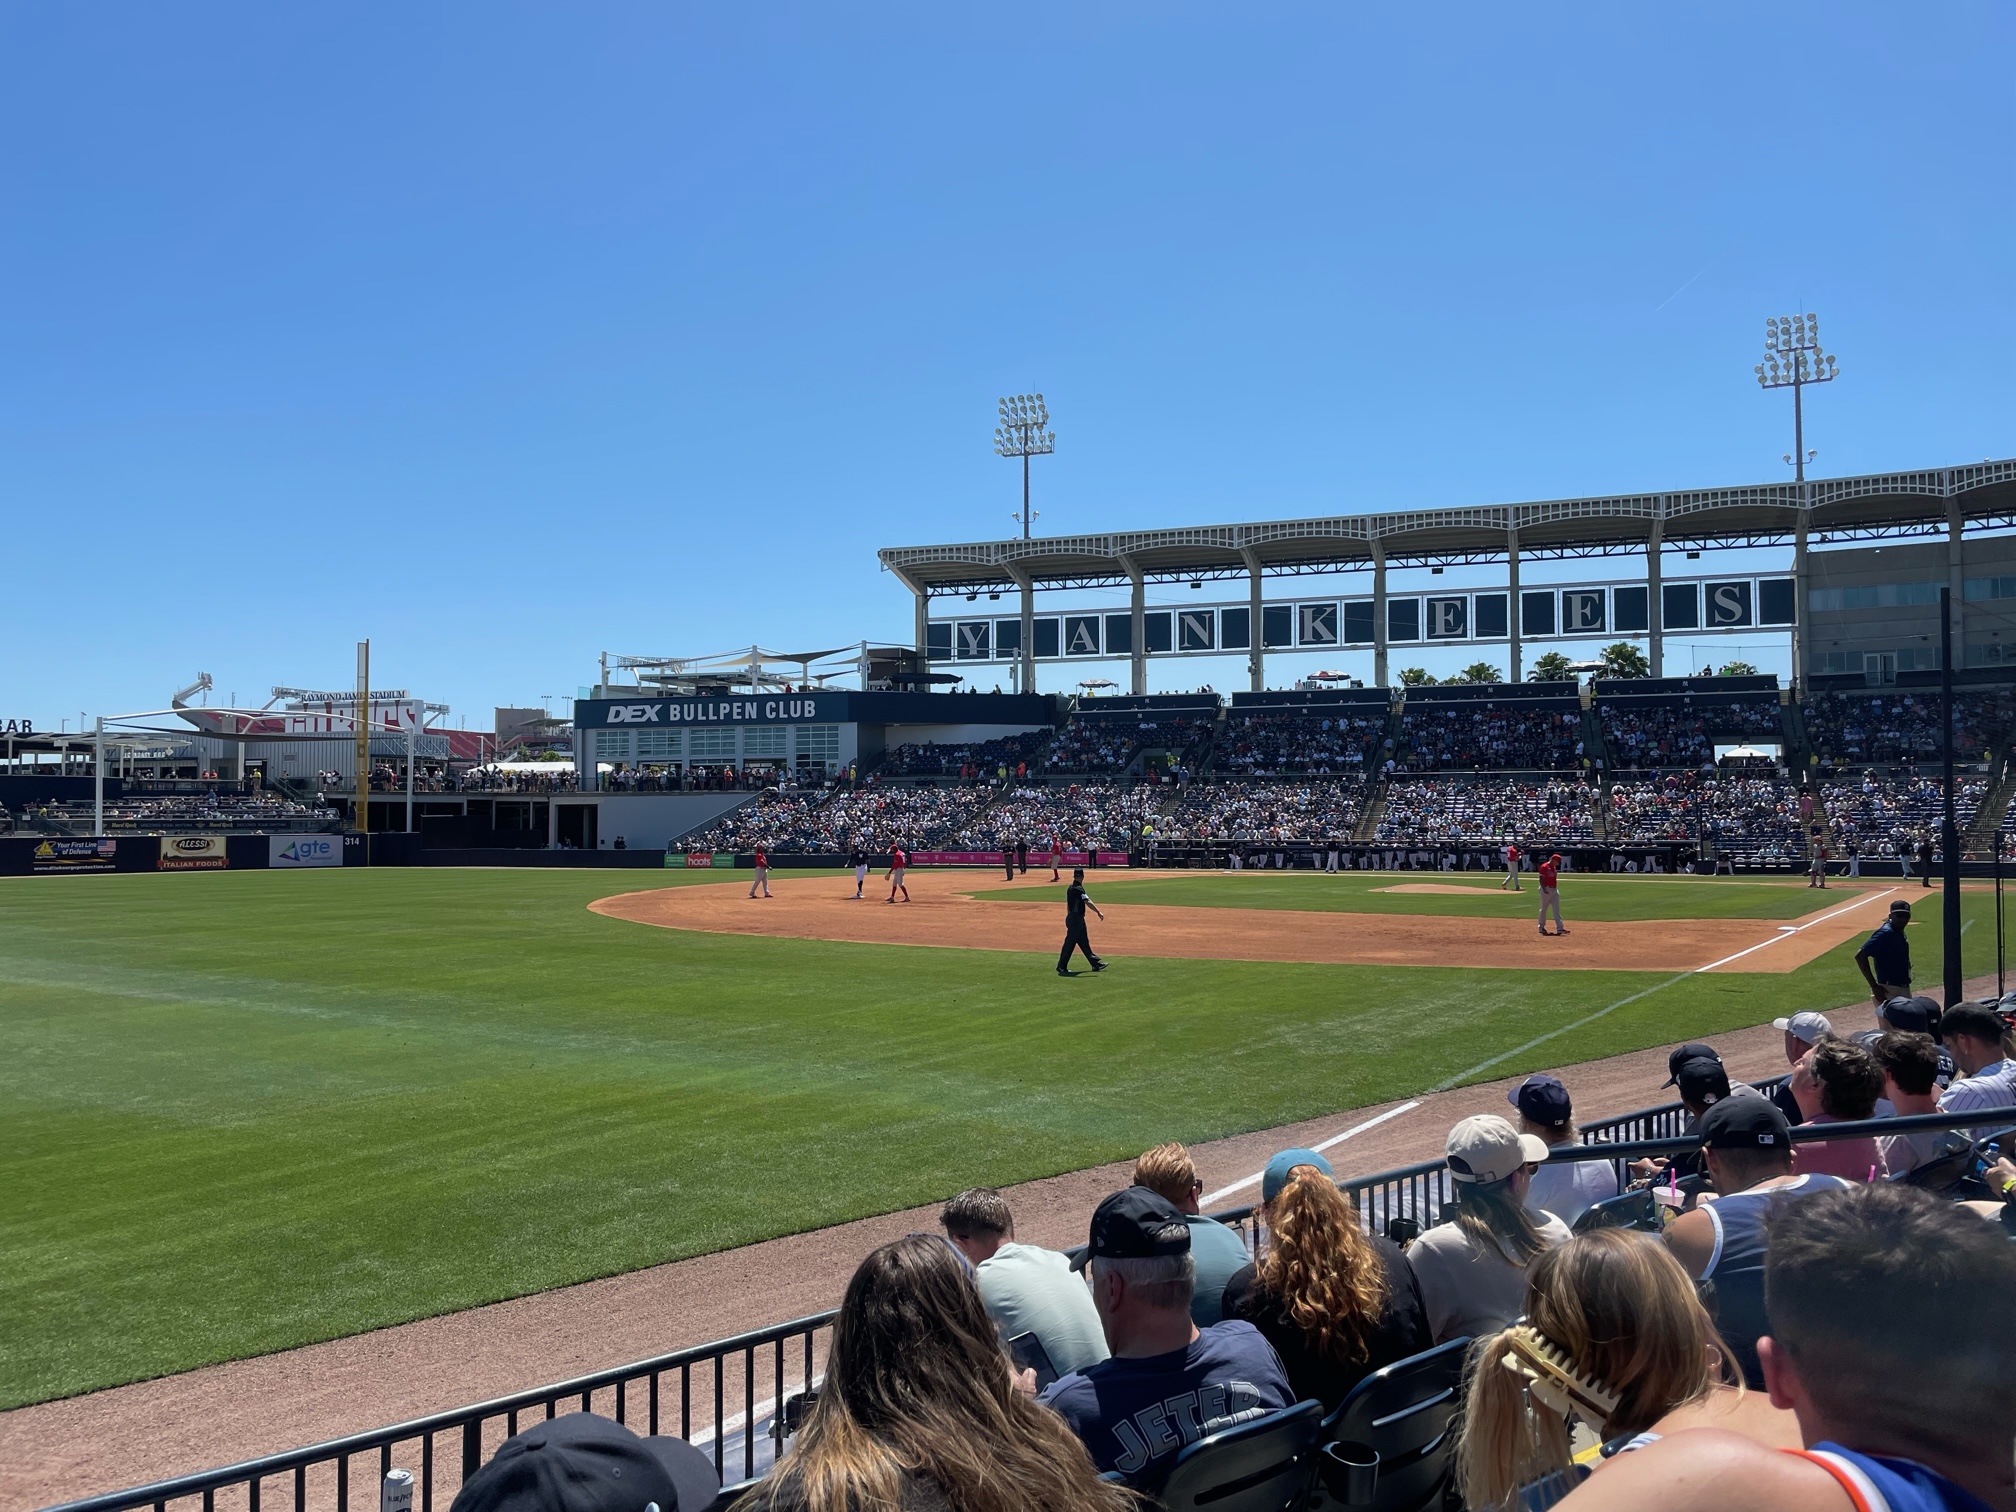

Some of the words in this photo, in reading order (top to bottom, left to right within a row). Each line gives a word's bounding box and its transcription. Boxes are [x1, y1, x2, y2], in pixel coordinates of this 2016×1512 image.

[301, 692, 342, 702] RAYMOND
[369, 690, 405, 700] STADIUM
[606, 704, 663, 723] DEX
[669, 702, 758, 721] BULLPEN
[765, 700, 816, 719] CLUB
[0, 719, 32, 733] AR
[57, 841, 71, 849] Your
[85, 840, 97, 848] Line
[180, 840, 208, 848] ALESSI
[344, 837, 360, 846] 314
[300, 840, 331, 858] gte
[687, 857, 711, 866] hoots
[1111, 1380, 1266, 1474] JETER
